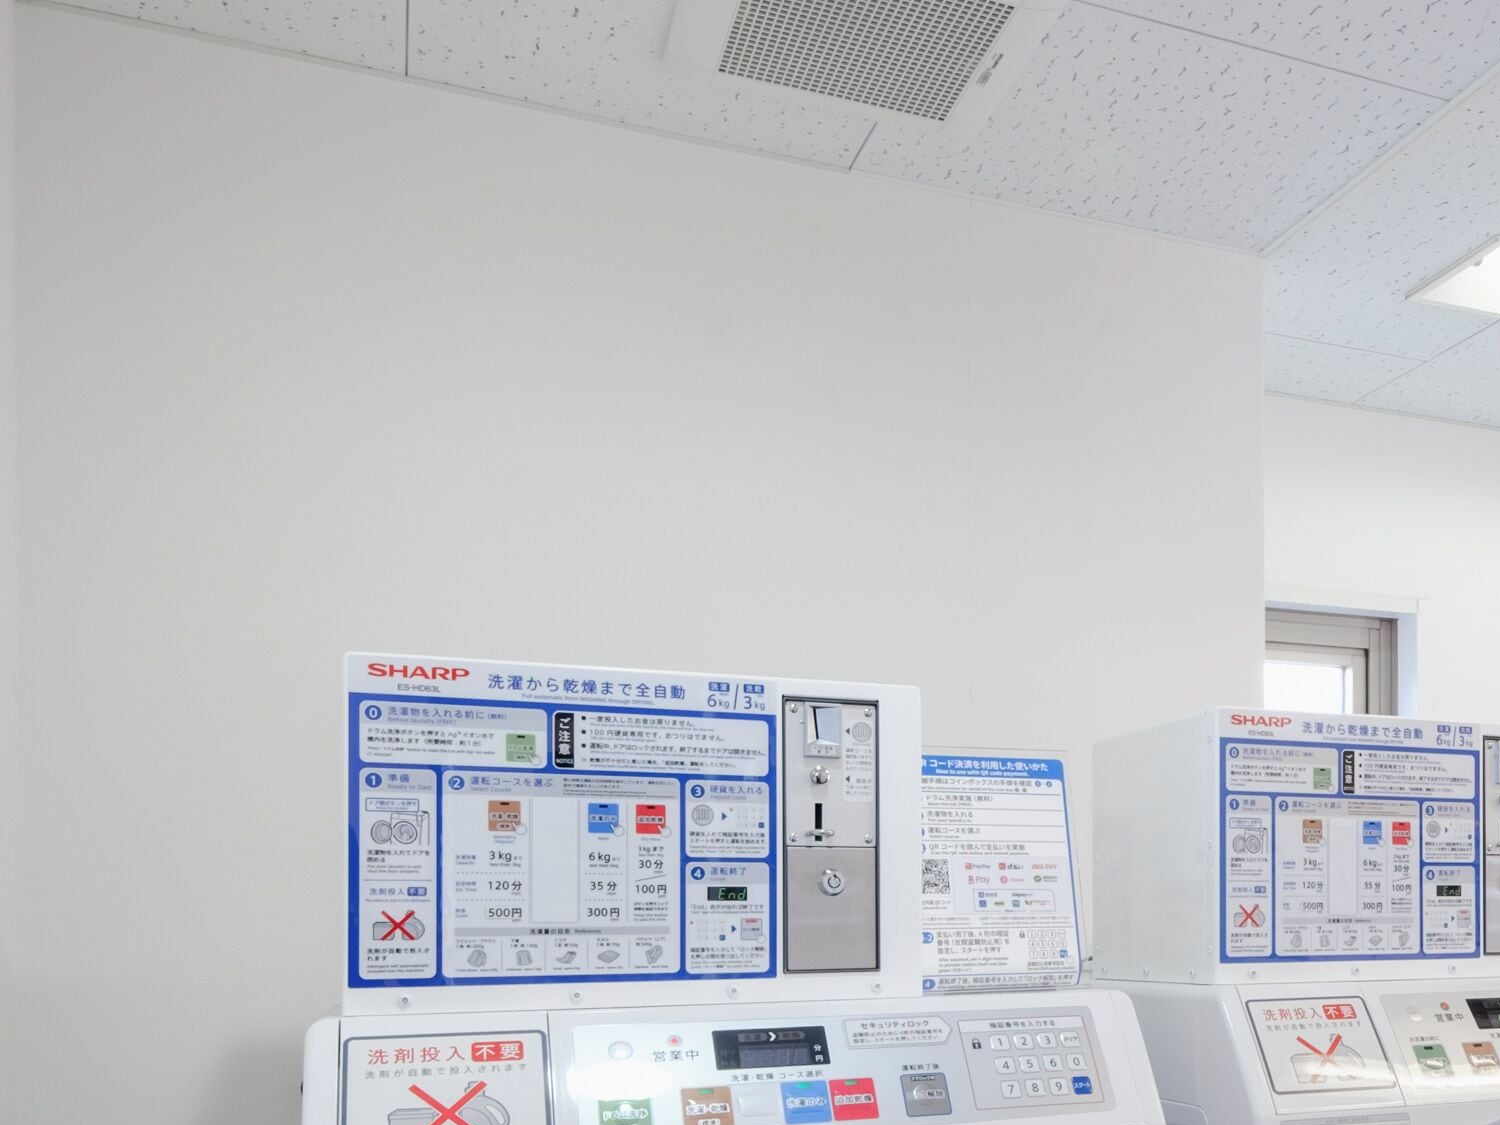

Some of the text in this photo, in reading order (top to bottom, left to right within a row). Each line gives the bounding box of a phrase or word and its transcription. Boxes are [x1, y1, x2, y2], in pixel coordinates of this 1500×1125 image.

[368, 663, 470, 681] SHARP
[488, 674, 686, 699] 洗濯から乾燥まで全自動
[388, 706, 484, 720] 洗濯物を入れる前に
[1231, 714, 1292, 728] SHARP
[1302, 721, 1423, 739] 洗濯から乾燥まで全自動
[559, 717, 571, 755] ご注意
[388, 774, 409, 783] 準備
[471, 776, 553, 787] 運転コースを選ぶ
[710, 784, 762, 794] 硬貨を入れる
[638, 859, 664, 870] 30分
[710, 866, 747, 876] 運転終了
[488, 880, 522, 891] 120分
[590, 880, 617, 892] 35分
[635, 884, 667, 895] 100円
[1302, 881, 1323, 890] 120分
[1391, 884, 1412, 893] 100円
[717, 887, 747, 900] End
[1302, 902, 1324, 911] 500円
[1362, 902, 1383, 911] 300円
[488, 907, 522, 918] 500円
[587, 907, 620, 918] 300円
[1263, 1006, 1355, 1021] 洗剤投入 不要
[1434, 1013, 1464, 1022] 営業中
[861, 1020, 930, 1029] セキュリティロック
[989, 1019, 1056, 1029] 暗証番号を入力する
[1020, 1036, 1028, 1046] 2
[1044, 1036, 1051, 1045] 3
[368, 1043, 521, 1065] 洗剤投入 不要
[653, 1049, 700, 1062] 営業中
[902, 1063, 939, 1071] 運転終了後
[1002, 1056, 1080, 1071] 4 5 6 0
[364, 1063, 528, 1079] 洗剤が自動で投入されます
[1007, 1084, 1014, 1094] 7
[1031, 1083, 1039, 1092] 8
[1054, 1082, 1062, 1091] 9
[787, 1097, 825, 1107] 洗濯のみ
[834, 1094, 873, 1105] 追加乾燥
